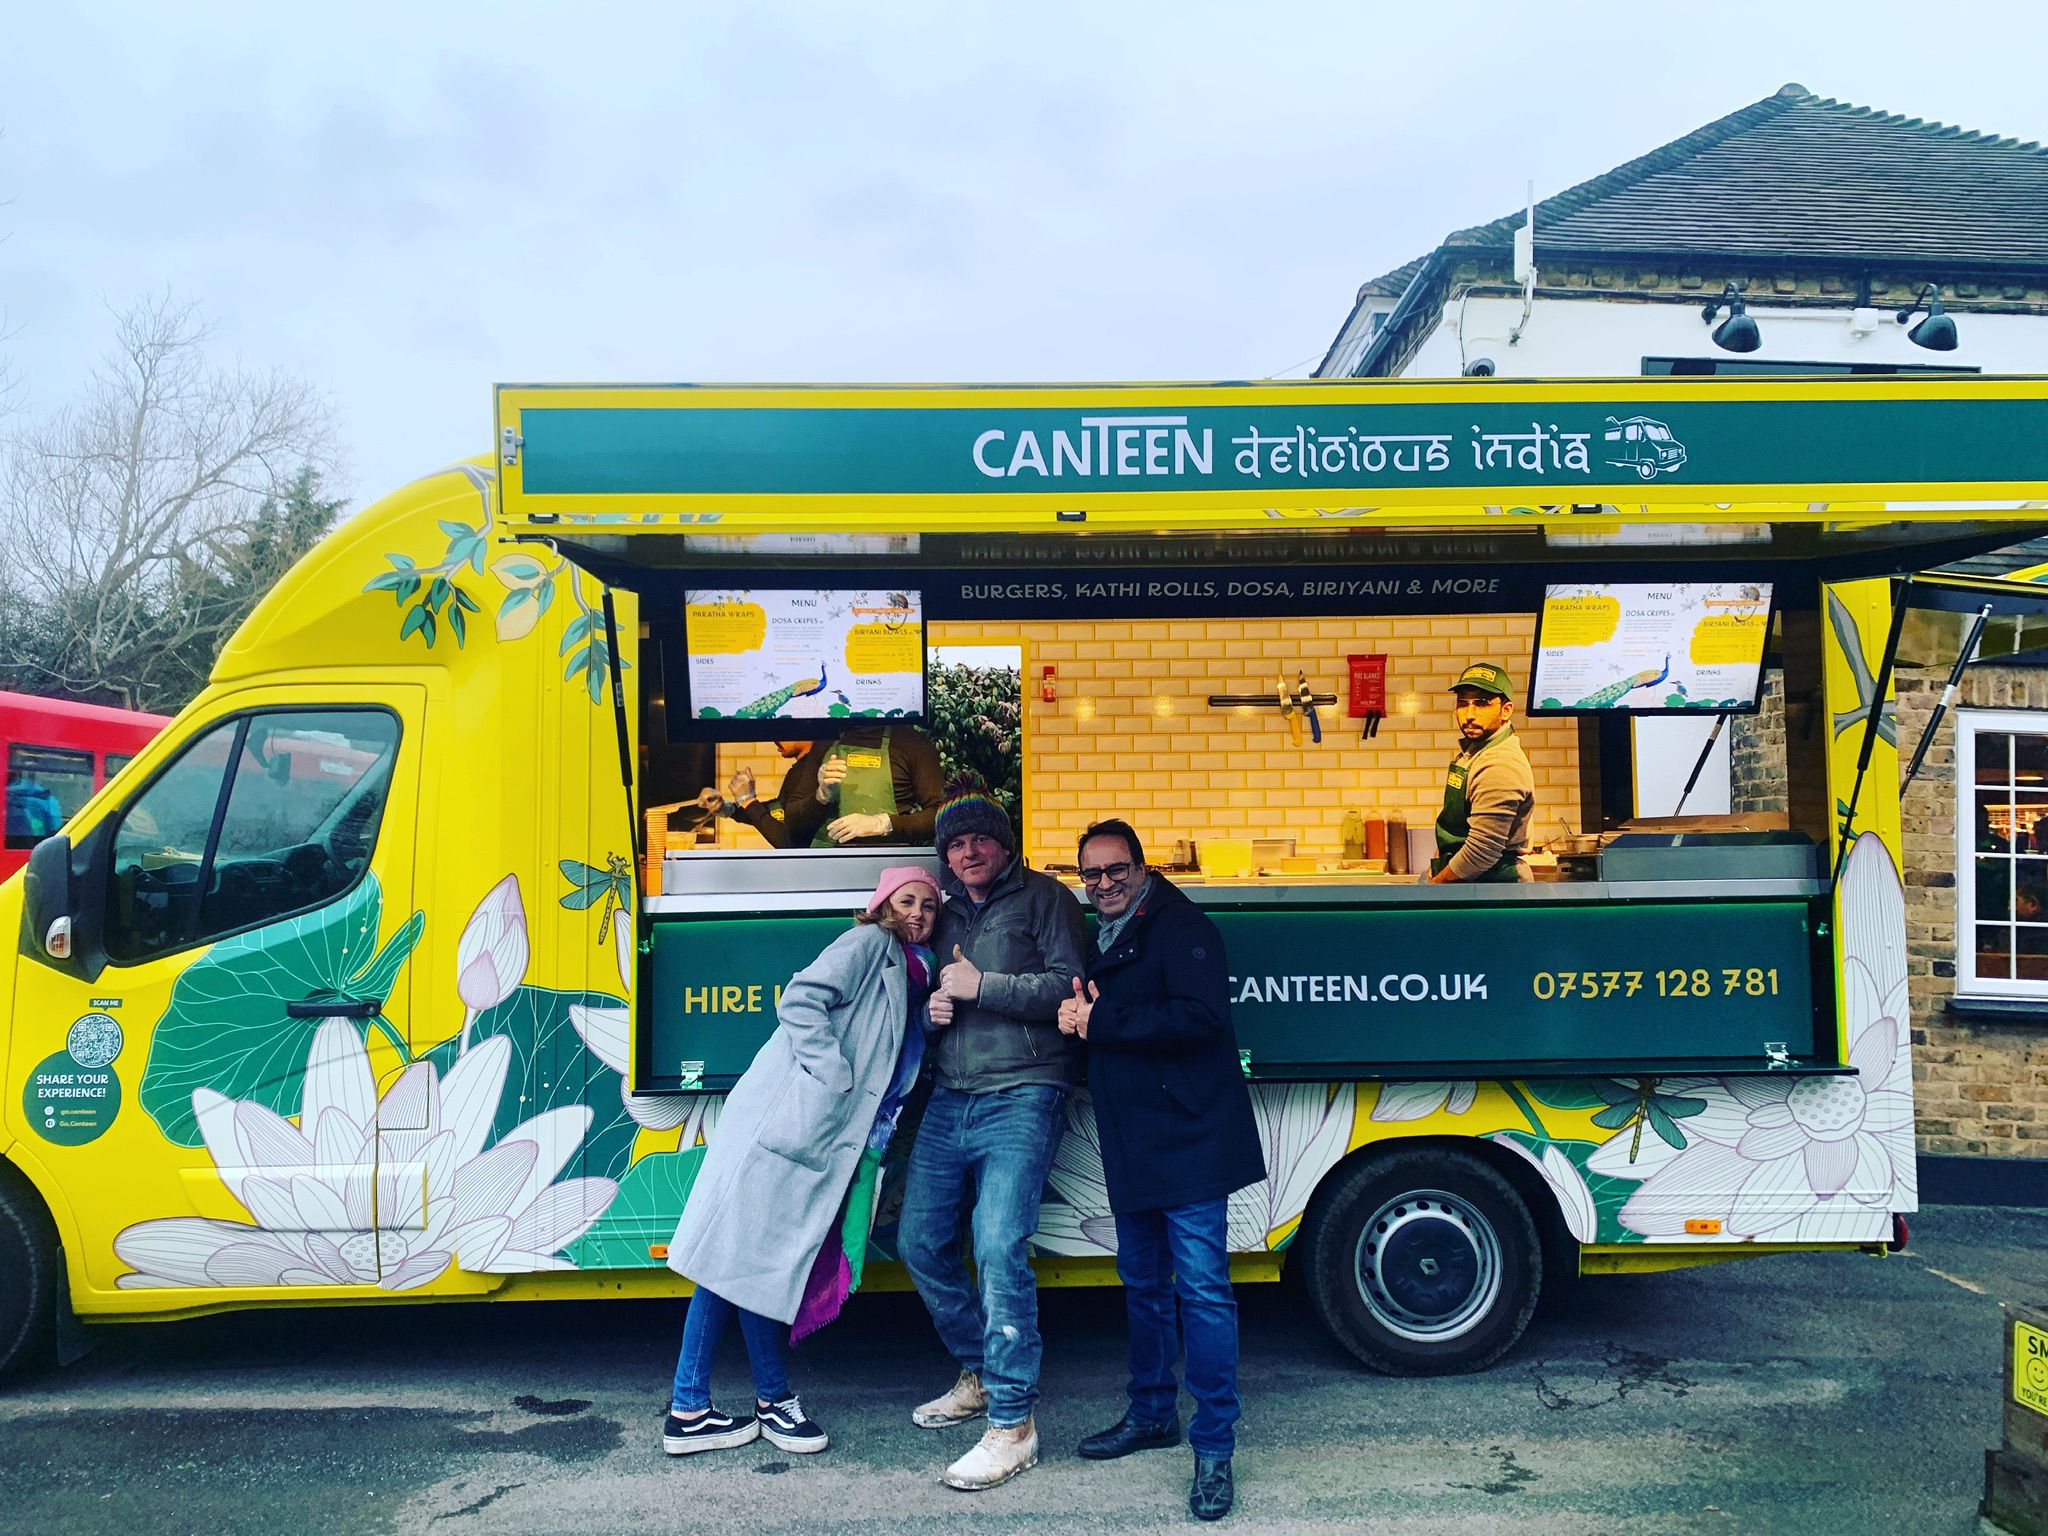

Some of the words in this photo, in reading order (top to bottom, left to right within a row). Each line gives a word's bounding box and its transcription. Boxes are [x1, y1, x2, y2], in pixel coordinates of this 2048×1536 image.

[972, 415, 1213, 478] CANTEEN
[1231, 424, 1453, 479] delicious
[1471, 422, 1591, 475] india
[961, 583, 1068, 600] BURGERS,
[1075, 582, 1141, 598] KATHI
[1147, 581, 1220, 599] ROLLS,
[1227, 580, 1295, 599] DOSA,
[1302, 580, 1400, 596] BIRIYANI
[1406, 579, 1424, 595] &
[1431, 578, 1500, 594] MORE
[1647, 592, 1673, 600] MENU
[791, 599, 817, 607] MENU
[1625, 609, 1646, 617] DOSA
[772, 617, 793, 625] DOSA
[855, 678, 882, 686] DRINKS
[1533, 971, 1644, 1000] 07577
[1655, 968, 1711, 997] 128
[1722, 967, 1778, 996] 781
[93, 999, 109, 1007] SCAN
[109, 999, 119, 1007] ME
[685, 985, 745, 1014] HIRE
[36, 1074, 74, 1085] SHARE
[77, 1074, 109, 1085] YOUR
[37, 1087, 106, 1099] EXPERIENCE!
